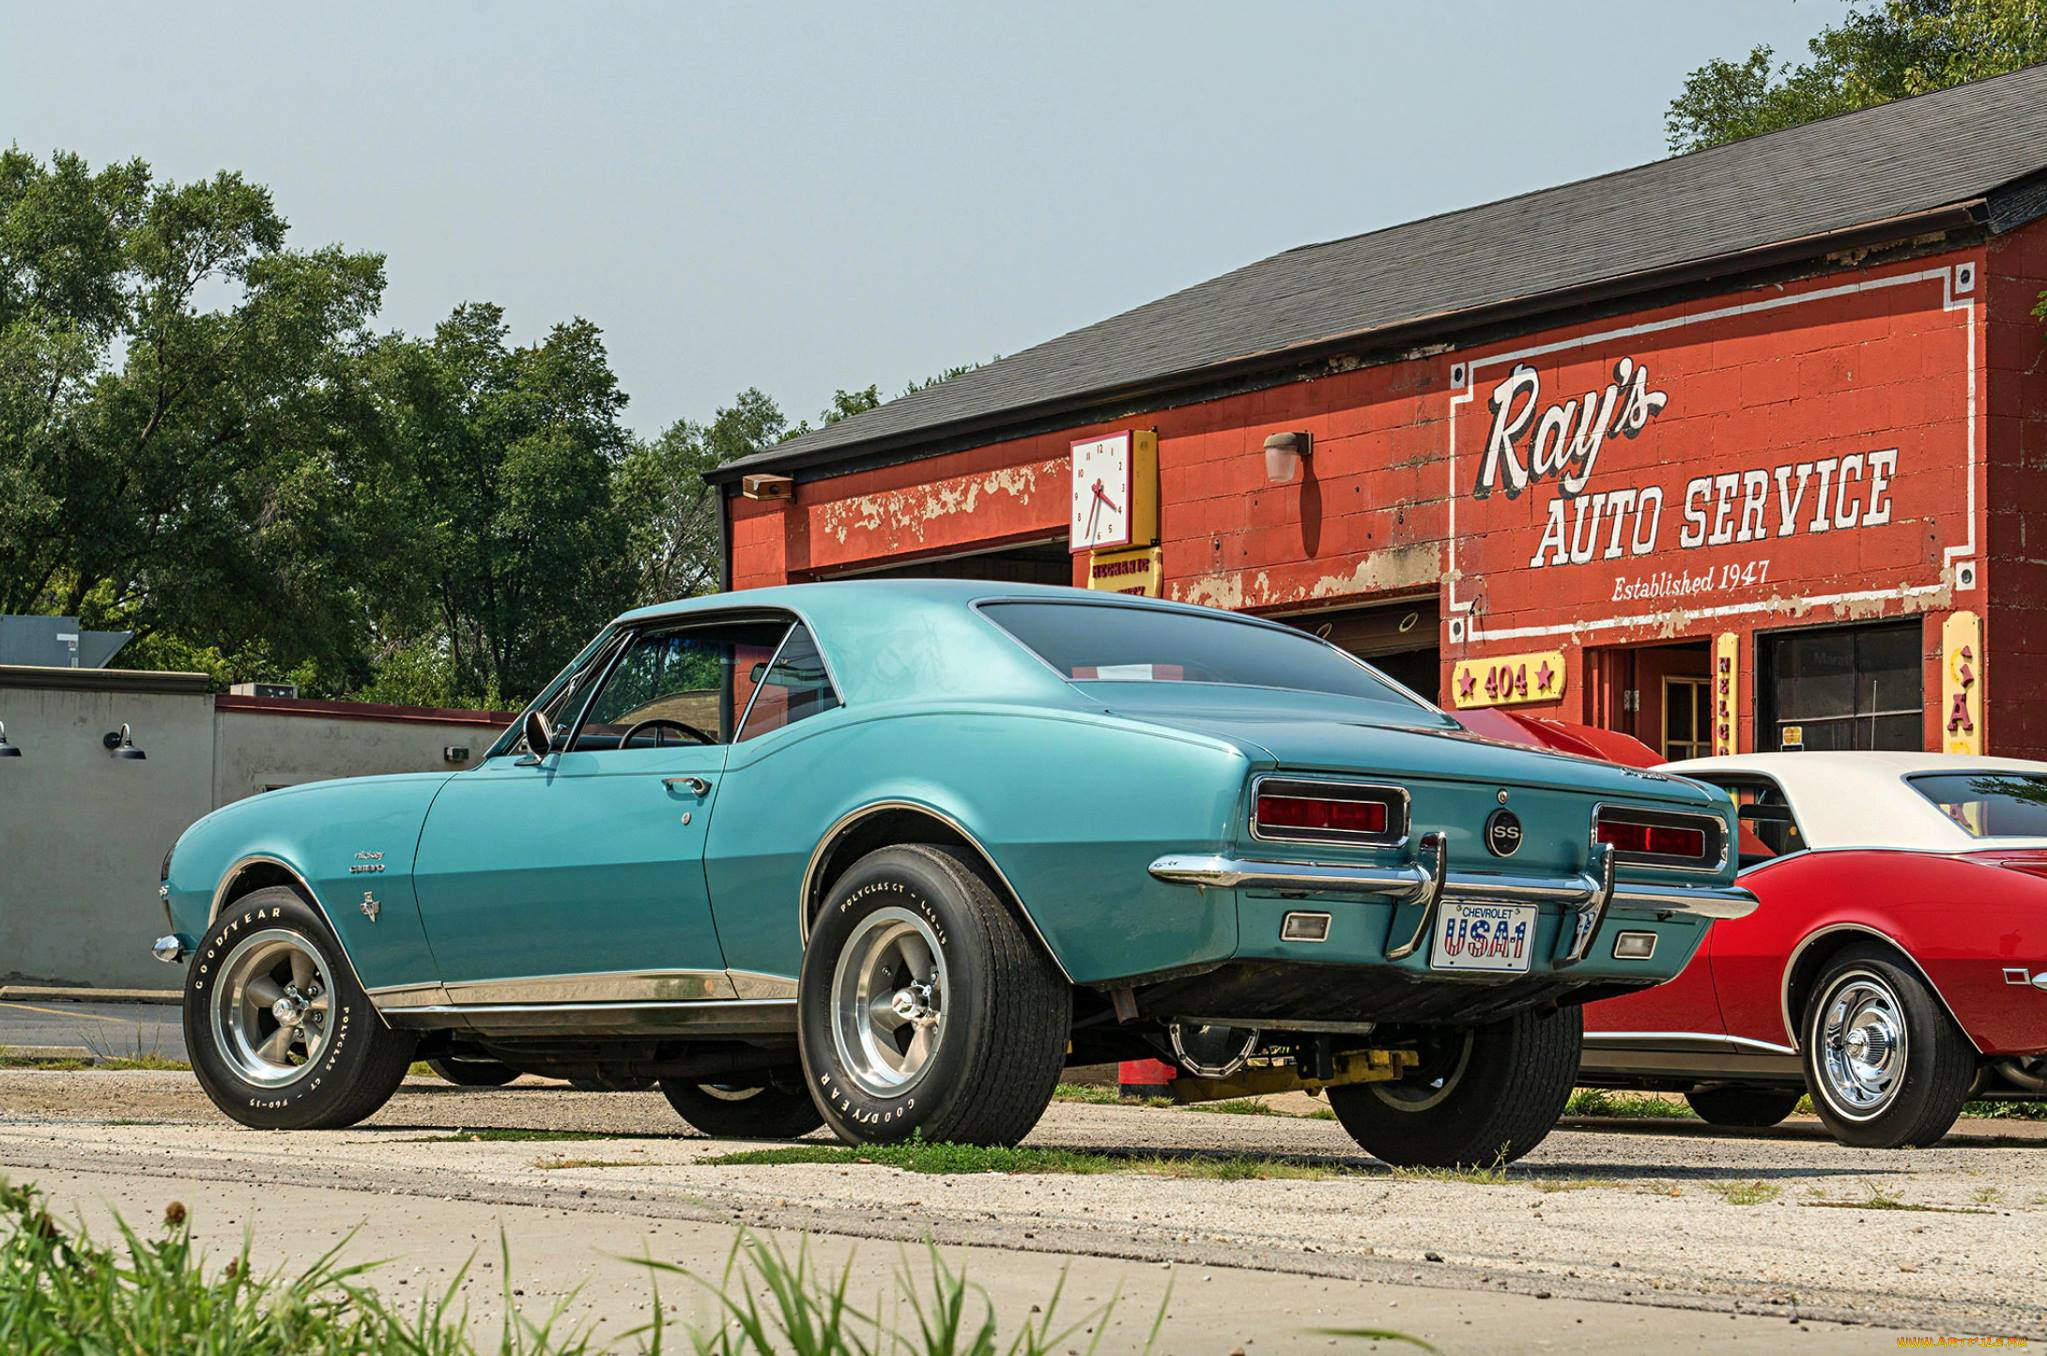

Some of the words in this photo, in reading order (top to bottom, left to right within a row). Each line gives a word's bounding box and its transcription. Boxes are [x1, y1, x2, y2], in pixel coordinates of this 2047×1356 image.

[1477, 356, 1668, 497] Ray's
[1530, 485, 1665, 568] AUTO
[1679, 447, 1899, 549] SERVICE
[1611, 566, 1716, 602] Established
[1717, 560, 1770, 594] 1947
[1485, 663, 1528, 698] 404
[1494, 825, 1519, 839] SS
[840, 881, 889, 913] POLYGLAS
[892, 883, 905, 894] GT
[1462, 906, 1513, 919] CHEVROLET
[195, 907, 281, 990] GOODYEAR
[325, 1006, 350, 1072] POLYGLAS
[820, 1072, 915, 1124] GOODYEAR
